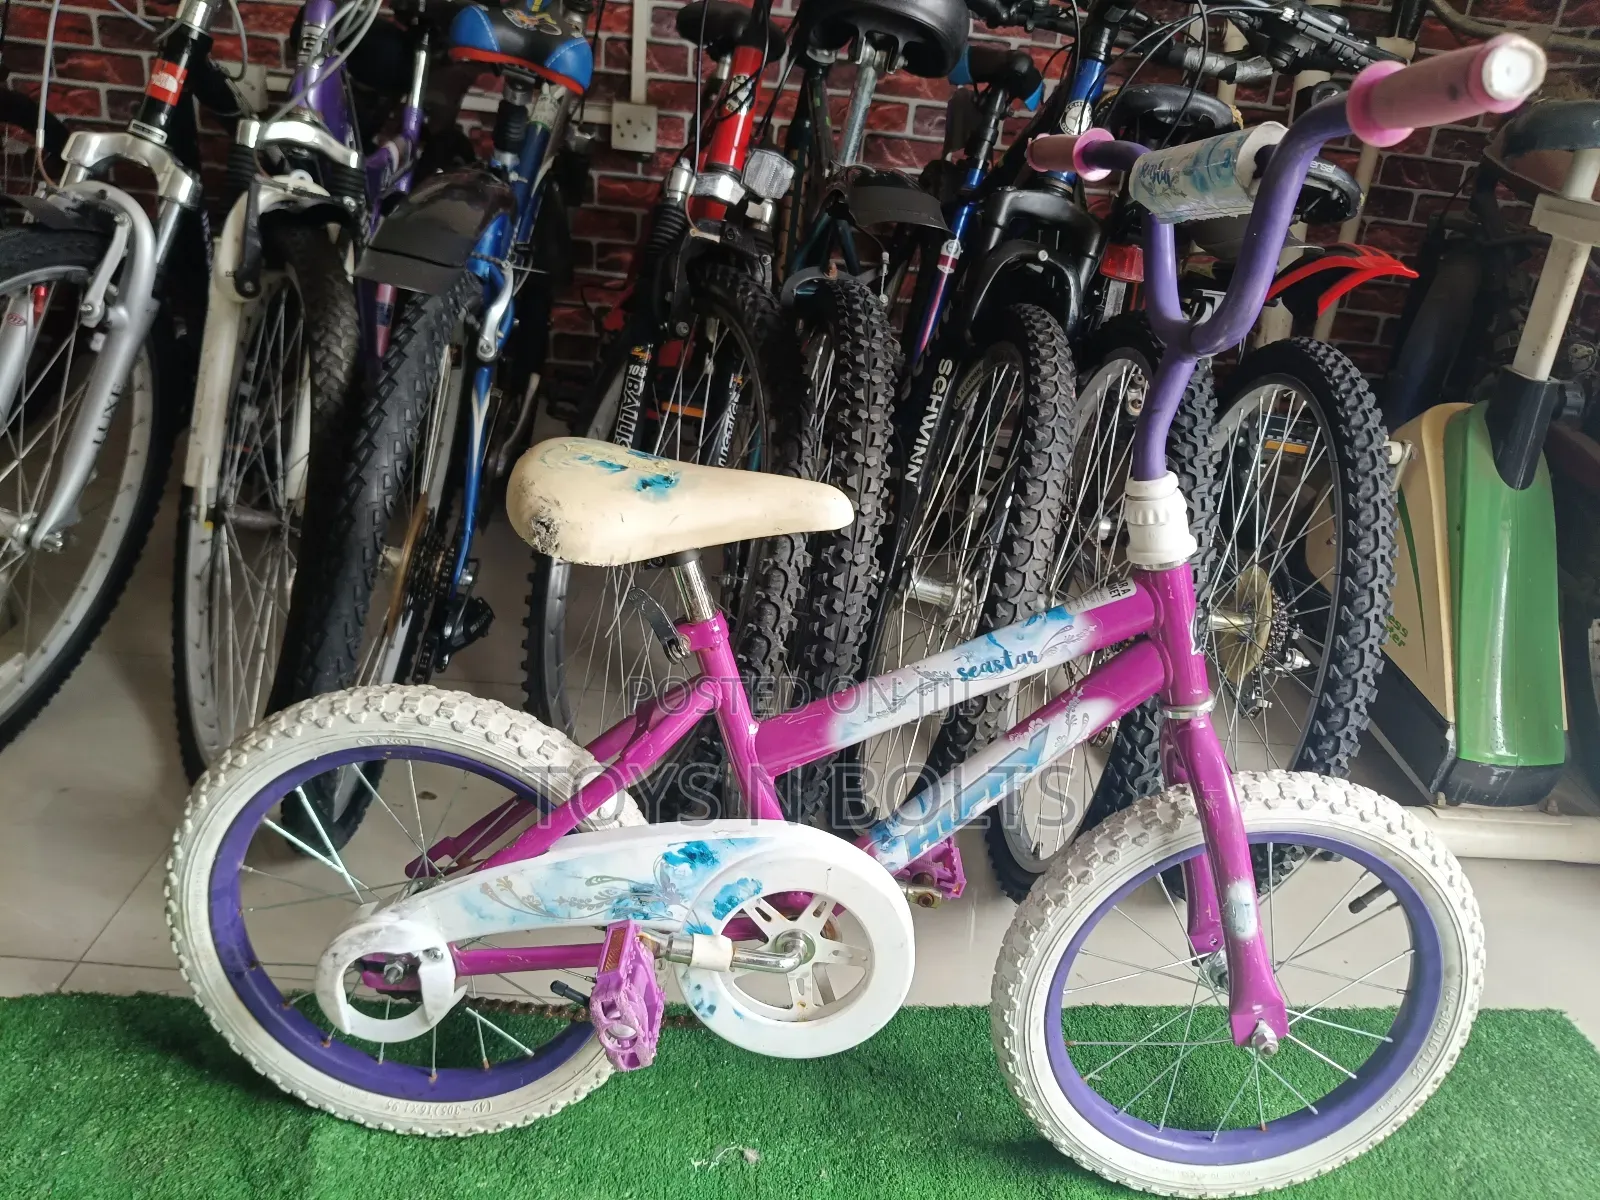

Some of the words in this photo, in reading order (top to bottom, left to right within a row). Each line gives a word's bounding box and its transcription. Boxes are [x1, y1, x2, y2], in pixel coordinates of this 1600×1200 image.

[1309, 160, 1336, 173] ersal
[904, 358, 953, 483] SCHWINN
[957, 648, 1039, 682] seastar
